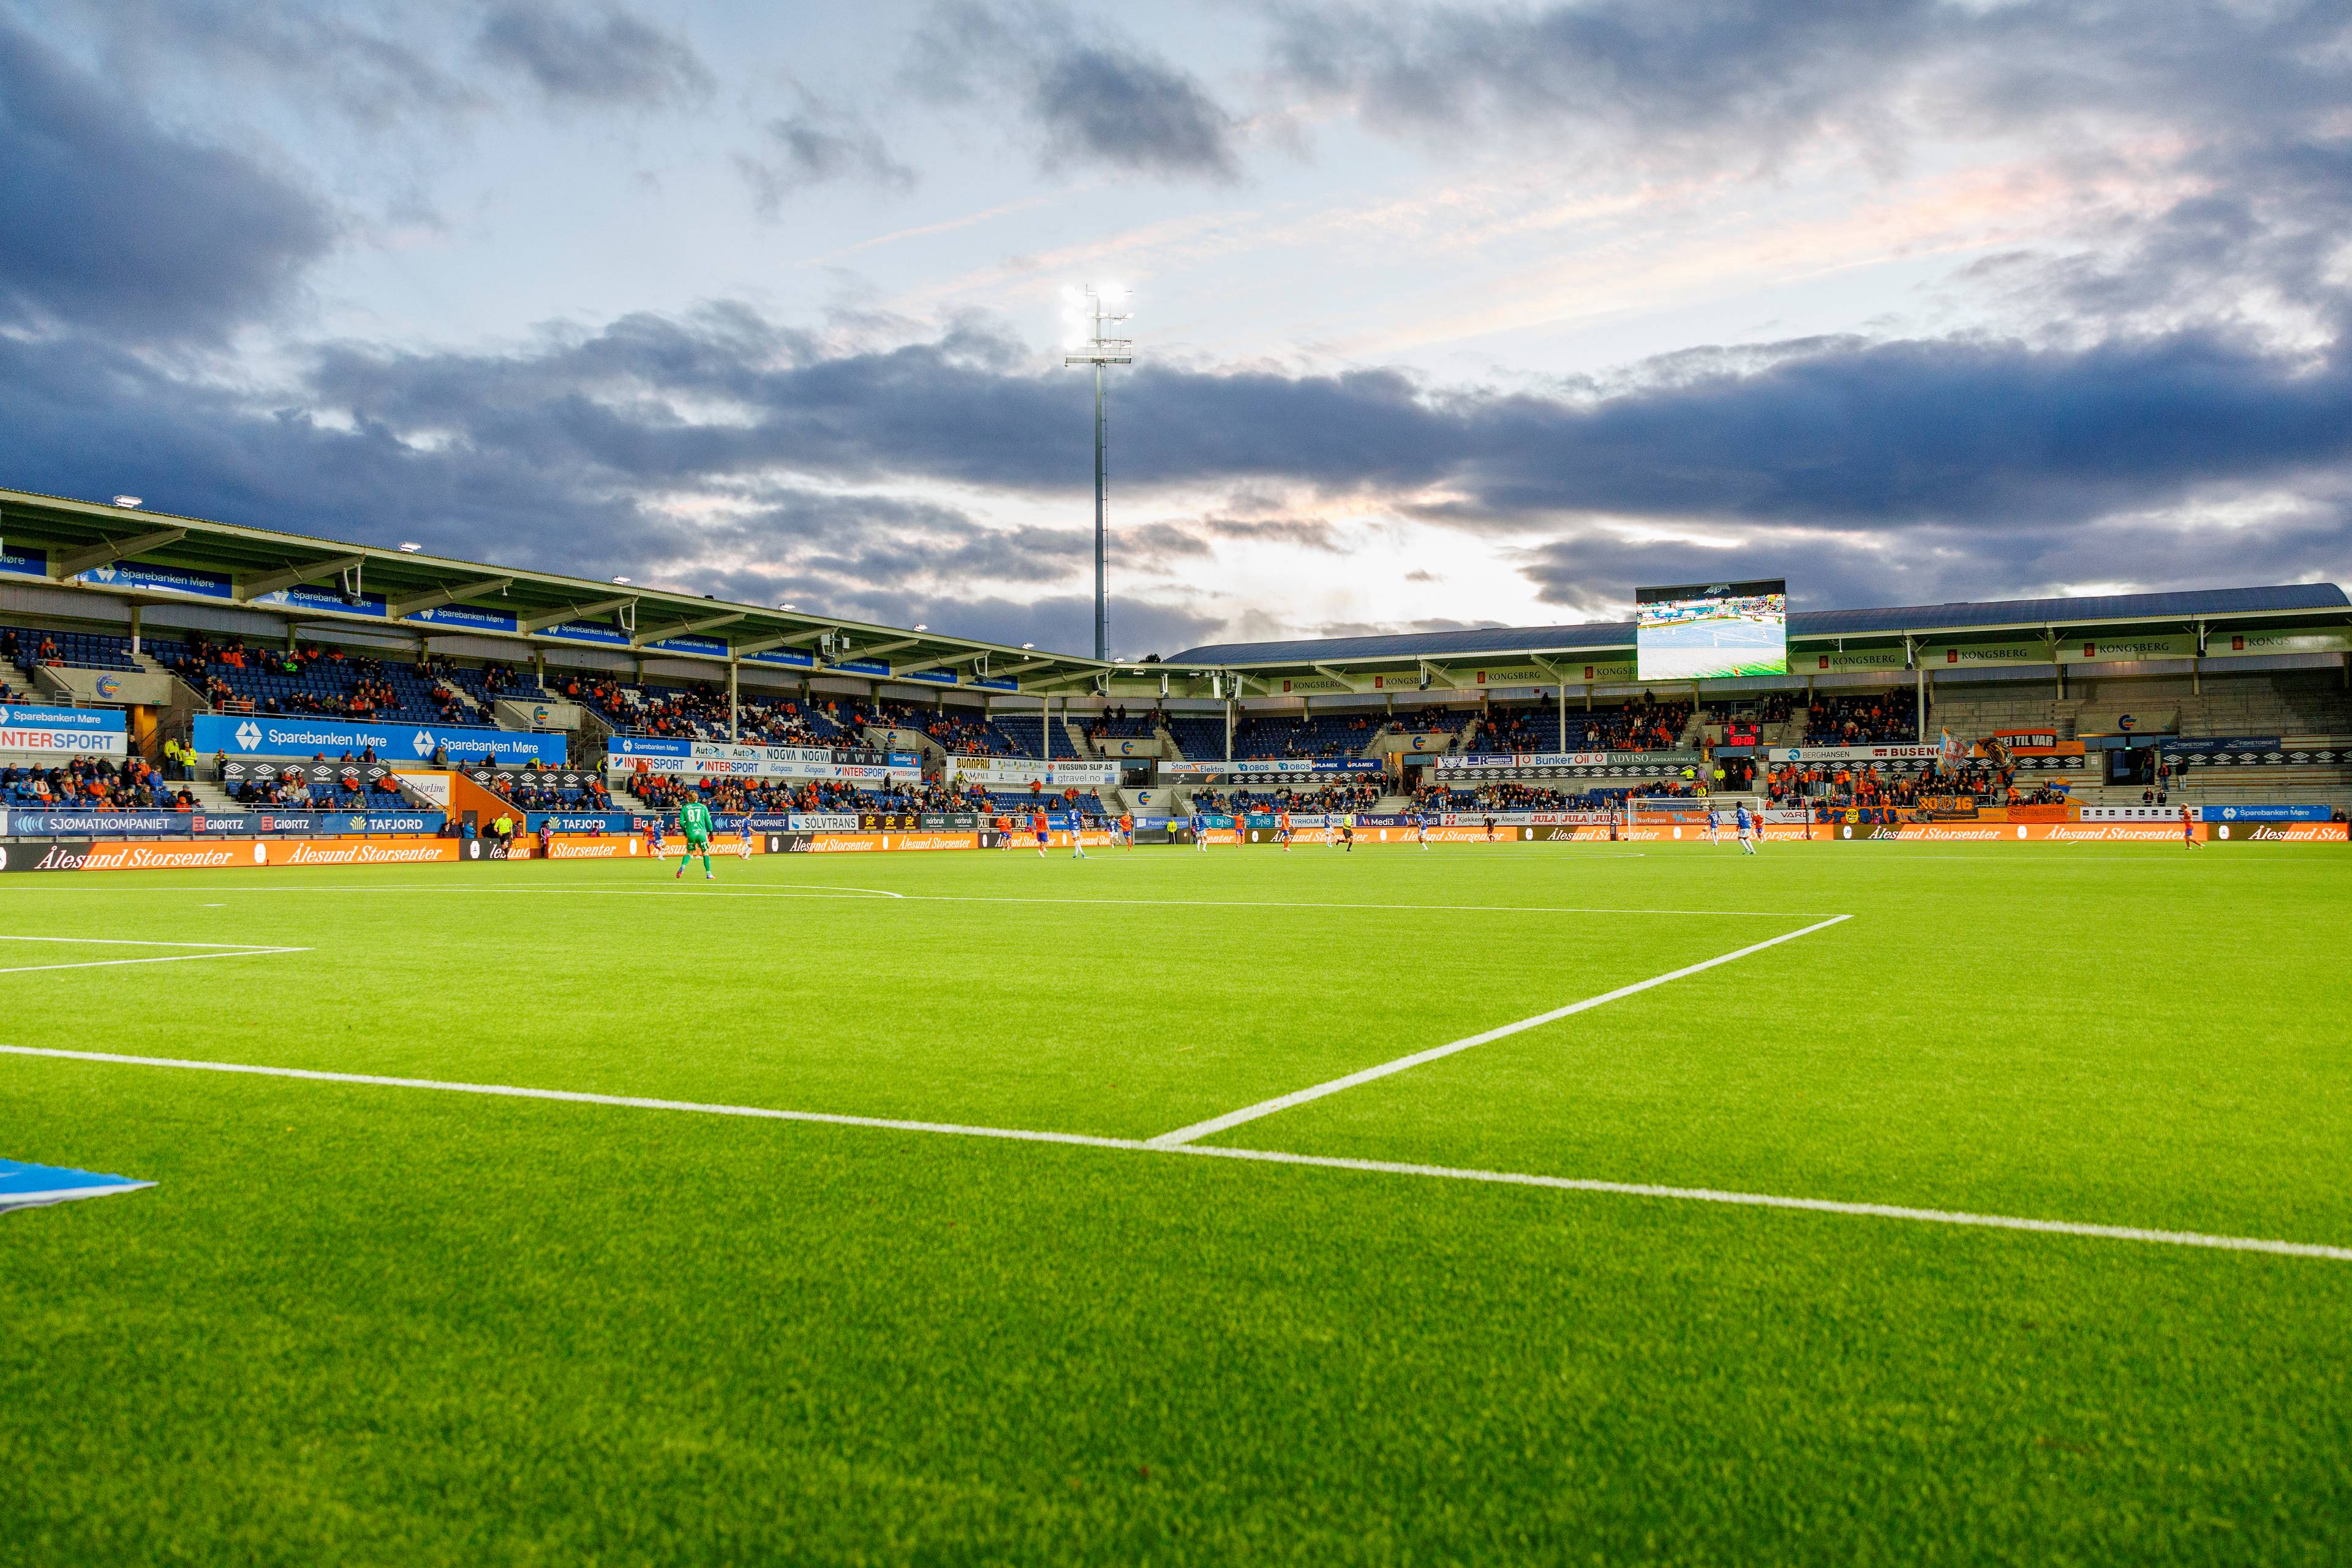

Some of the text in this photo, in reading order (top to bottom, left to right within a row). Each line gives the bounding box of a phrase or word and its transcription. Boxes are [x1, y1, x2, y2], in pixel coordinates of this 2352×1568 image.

[121, 568, 214, 589] Sparebanken Møre
[293, 590, 342, 604] Sparebanke
[437, 608, 504, 624] Sparebanken Møre
[562, 624, 619, 637] Sparebanken Møre
[668, 638, 704, 647] Sparebanken
[2100, 642, 2169, 653] KONGSBERG
[1833, 655, 1896, 665] KONGSBERG
[1962, 649, 2027, 660] KONGSBERG
[1488, 671, 1540, 681] KONGSBERG
[1597, 667, 1638, 676] KONGSB
[1386, 676, 1434, 685] KONGSBG
[13, 711, 101, 723] Sparebanken Møre
[1728, 726, 1735, 735] 2
[1750, 725, 1756, 734] 4
[2, 731, 113, 750] NTERSPORT
[268, 729, 387, 748] Sparebanken Møre
[1730, 736, 1755, 745] 90:00
[2015, 736, 2030, 746] TIL
[2032, 735, 2053, 746] VAR
[440, 738, 538, 754] Sparebanken Møre
[635, 742, 665, 751] Sparebanken
[695, 746, 725, 758] Auto 88
[1891, 747, 1940, 756] BUSEN
[733, 748, 750, 757] Auto
[767, 748, 796, 760] NOGVA
[802, 750, 829, 762] NOGVA
[1610, 754, 1648, 763] ADVISO
[1536, 754, 1589, 765] Bunker Oil
[705, 761, 758, 773] INTERSPORT
[771, 763, 793, 775] Bergans
[804, 764, 826, 775] Bergans
[843, 767, 886, 777] INTERSPORT
[1172, 762, 1191, 771] Storm
[1058, 774, 1100, 784] gtravel.no
[411, 783, 445, 793] Color Line
[1954, 797, 1974, 811] 16
[687, 809, 701, 822] 87
[1217, 816, 1231, 827] DNB
[1256, 816, 1270, 827] DNB
[50, 818, 170, 830] SJØMATKOMPANIET
[370, 819, 423, 830] TAFJORD
[730, 819, 786, 827] SJØTKOMPANIET
[1270, 830, 1312, 842] Ålsund
[1400, 829, 1504, 841] Åleund Storsener
[1547, 827, 1659, 840] Ålesund Strsenter
[1868, 825, 2001, 839] Ålesund Storsenter
[2044, 825, 2108, 839] Ålesund
[2248, 825, 2348, 840] Ålesund Sto
[790, 836, 873, 852] Ålesund Storsenter
[898, 835, 970, 850] Ålesund Storsenter
[287, 842, 442, 863] Ålesund Storsenter
[553, 843, 616, 858] Storsenter
[34, 845, 233, 869] Ålesund Storsenter
